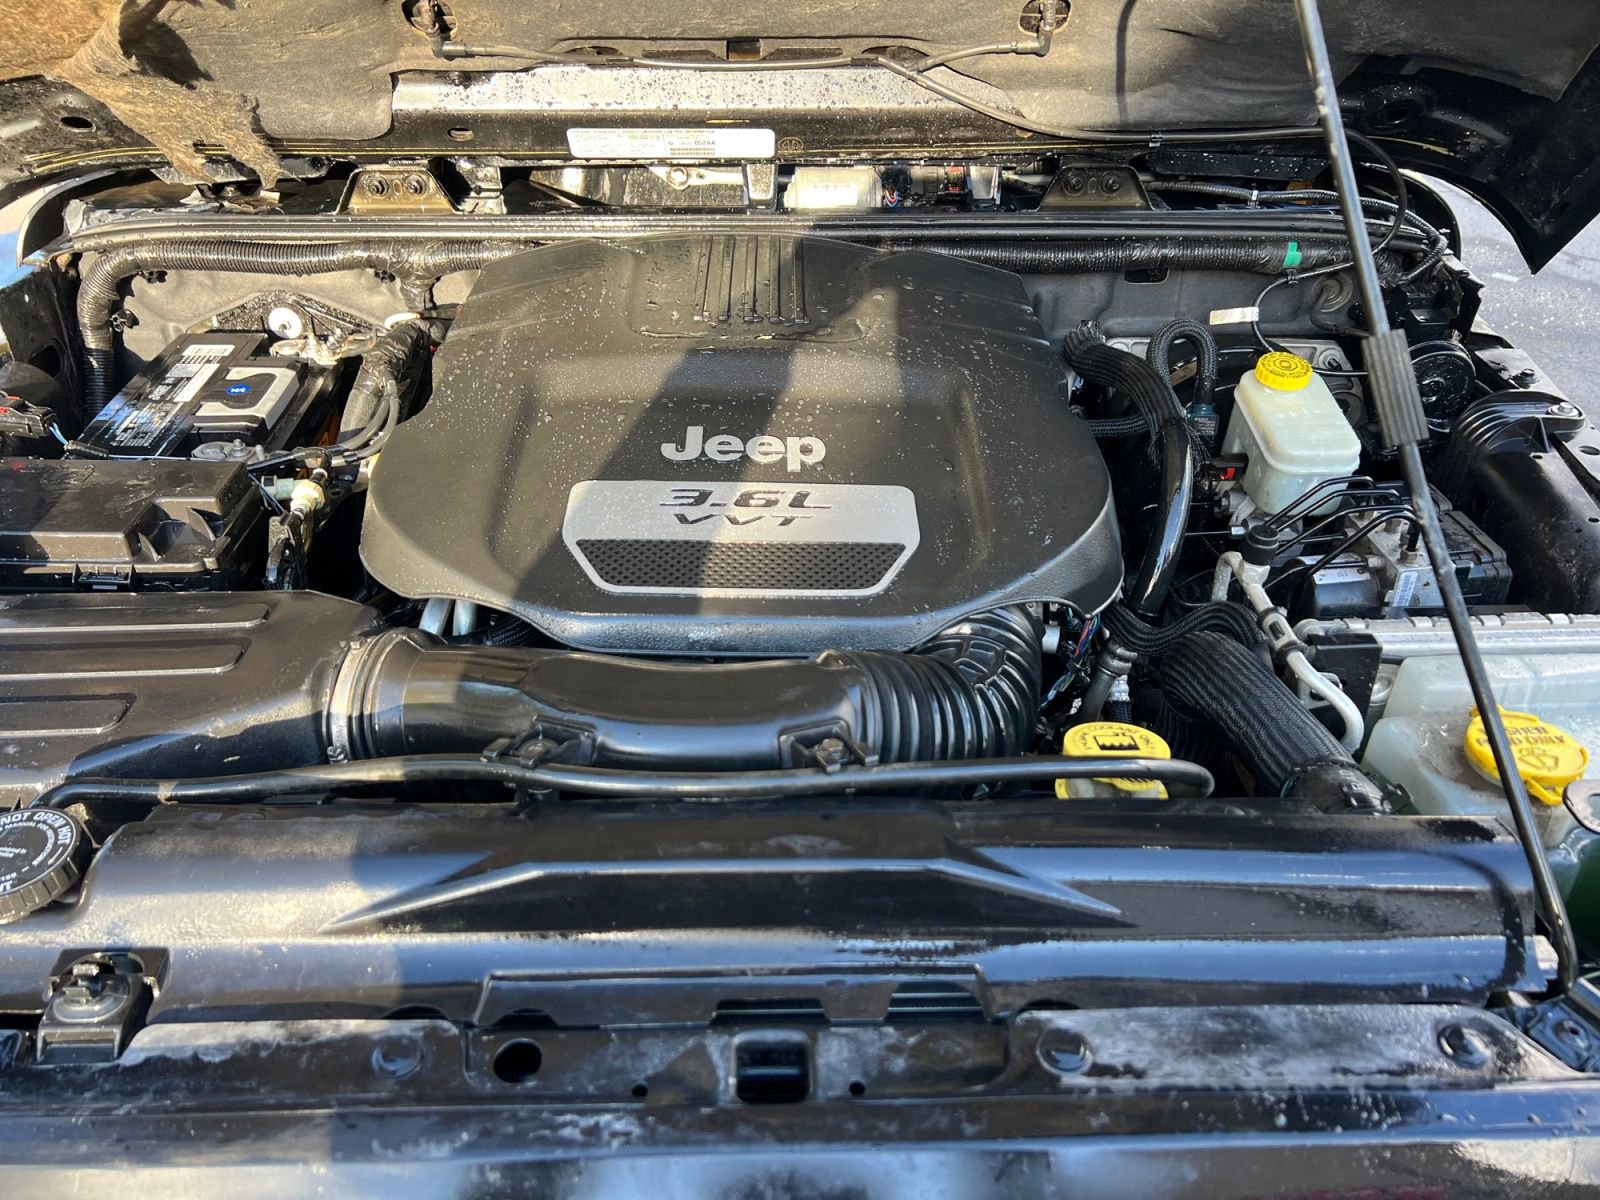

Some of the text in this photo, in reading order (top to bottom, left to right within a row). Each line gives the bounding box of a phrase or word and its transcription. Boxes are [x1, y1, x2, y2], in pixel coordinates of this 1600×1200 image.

[660, 425, 827, 473] Jeep
[659, 489, 832, 509] 3.6L
[673, 513, 813, 526] VVT
[0, 812, 72, 845] NOT OPEN HOT
